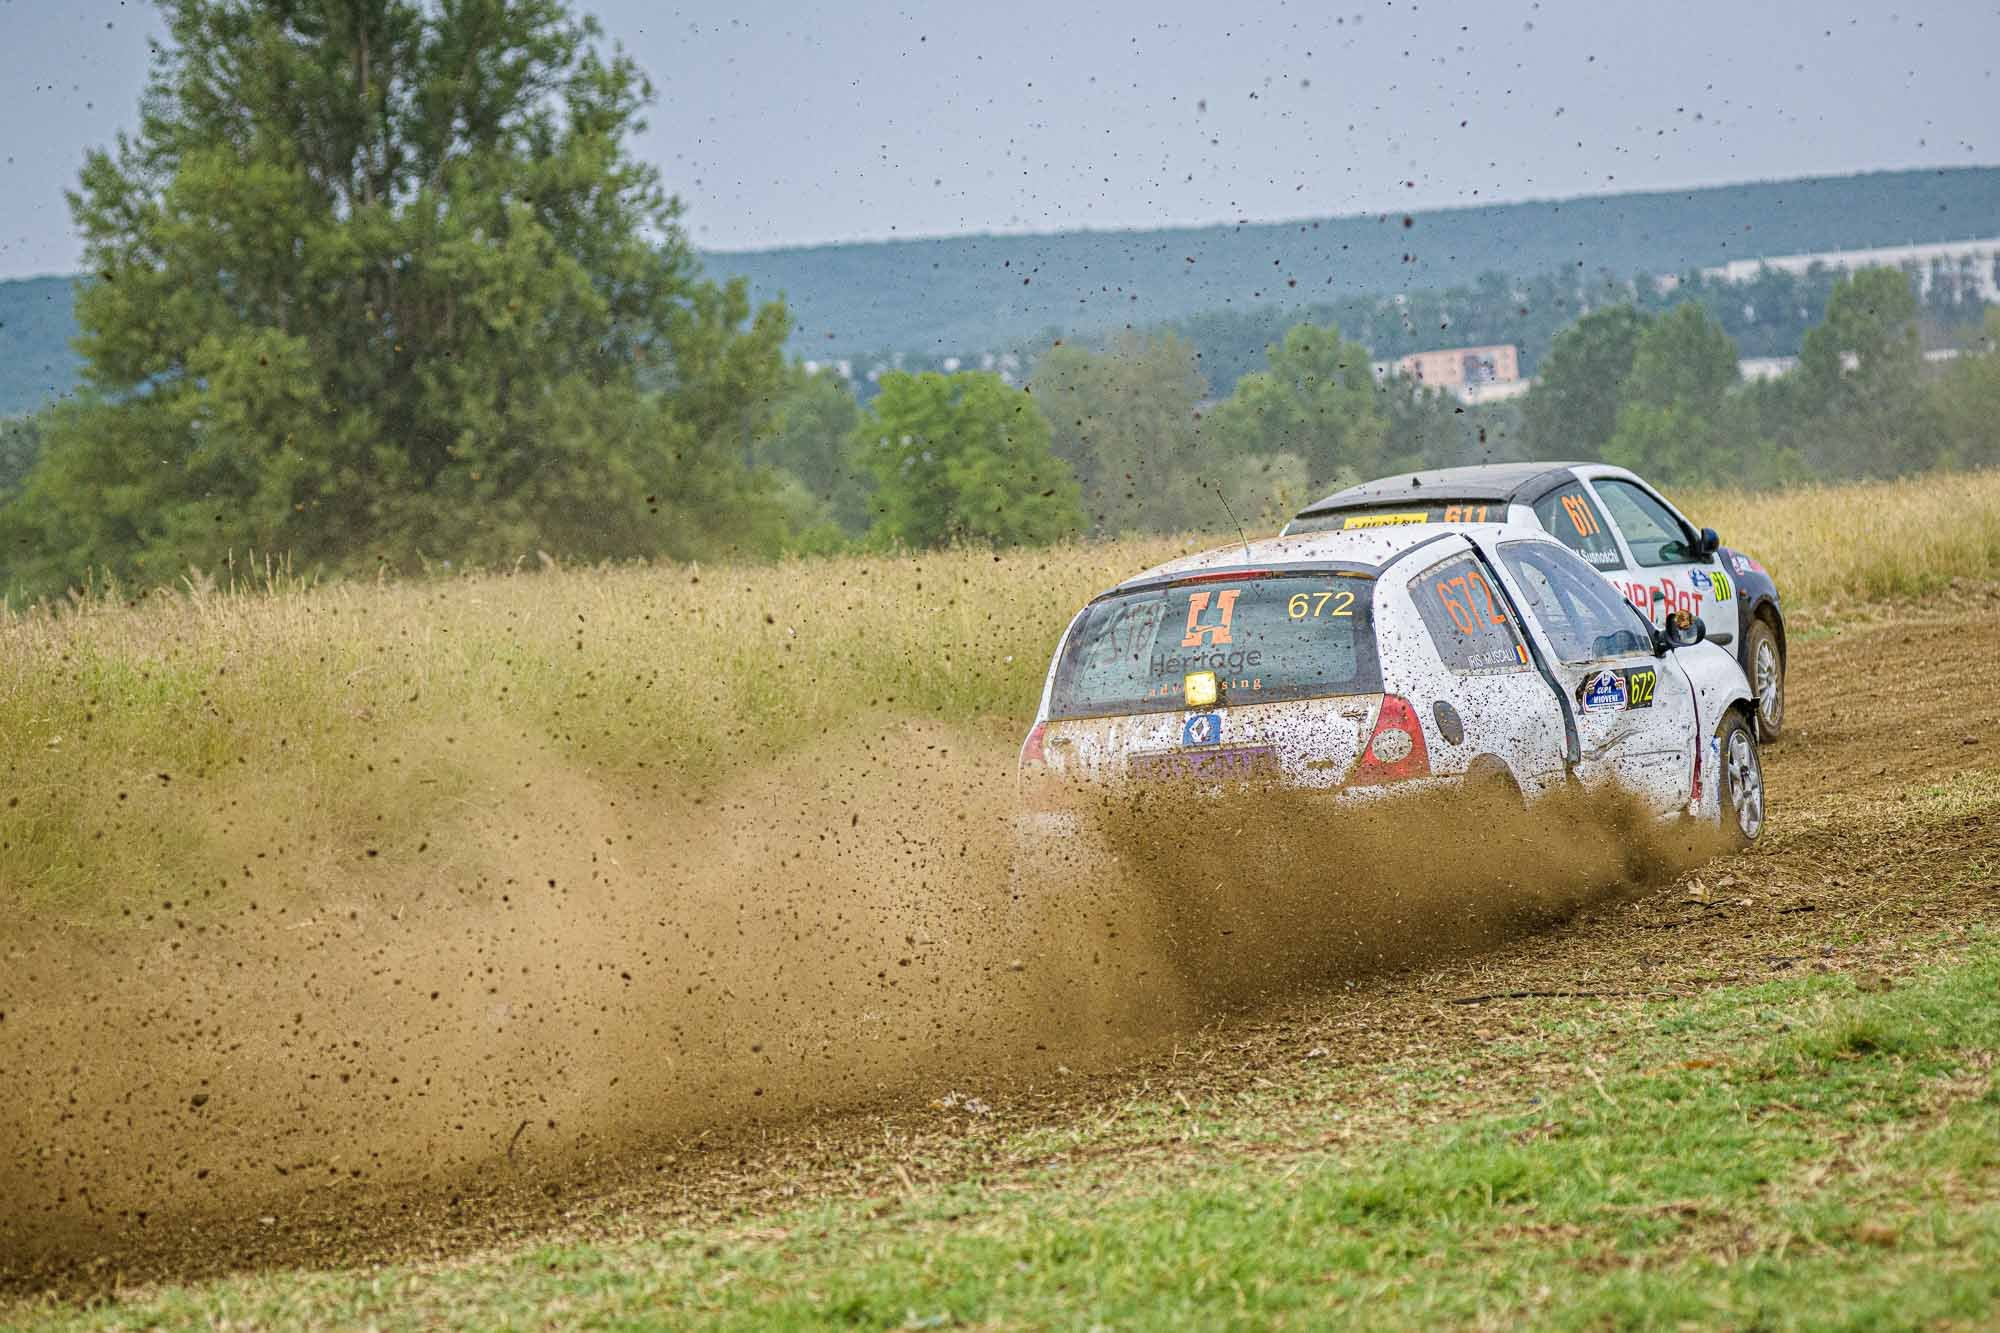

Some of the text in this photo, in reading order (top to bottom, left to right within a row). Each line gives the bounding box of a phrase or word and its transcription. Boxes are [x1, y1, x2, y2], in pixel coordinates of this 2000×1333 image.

[1561, 493, 1600, 537] 611
[1711, 571, 1732, 602] 611
[1288, 591, 1356, 618] 672
[1437, 571, 1506, 636] 672
[1150, 649, 1263, 676] Heritage
[1149, 678, 1263, 697] advsing
[1631, 671, 1656, 705] 672
